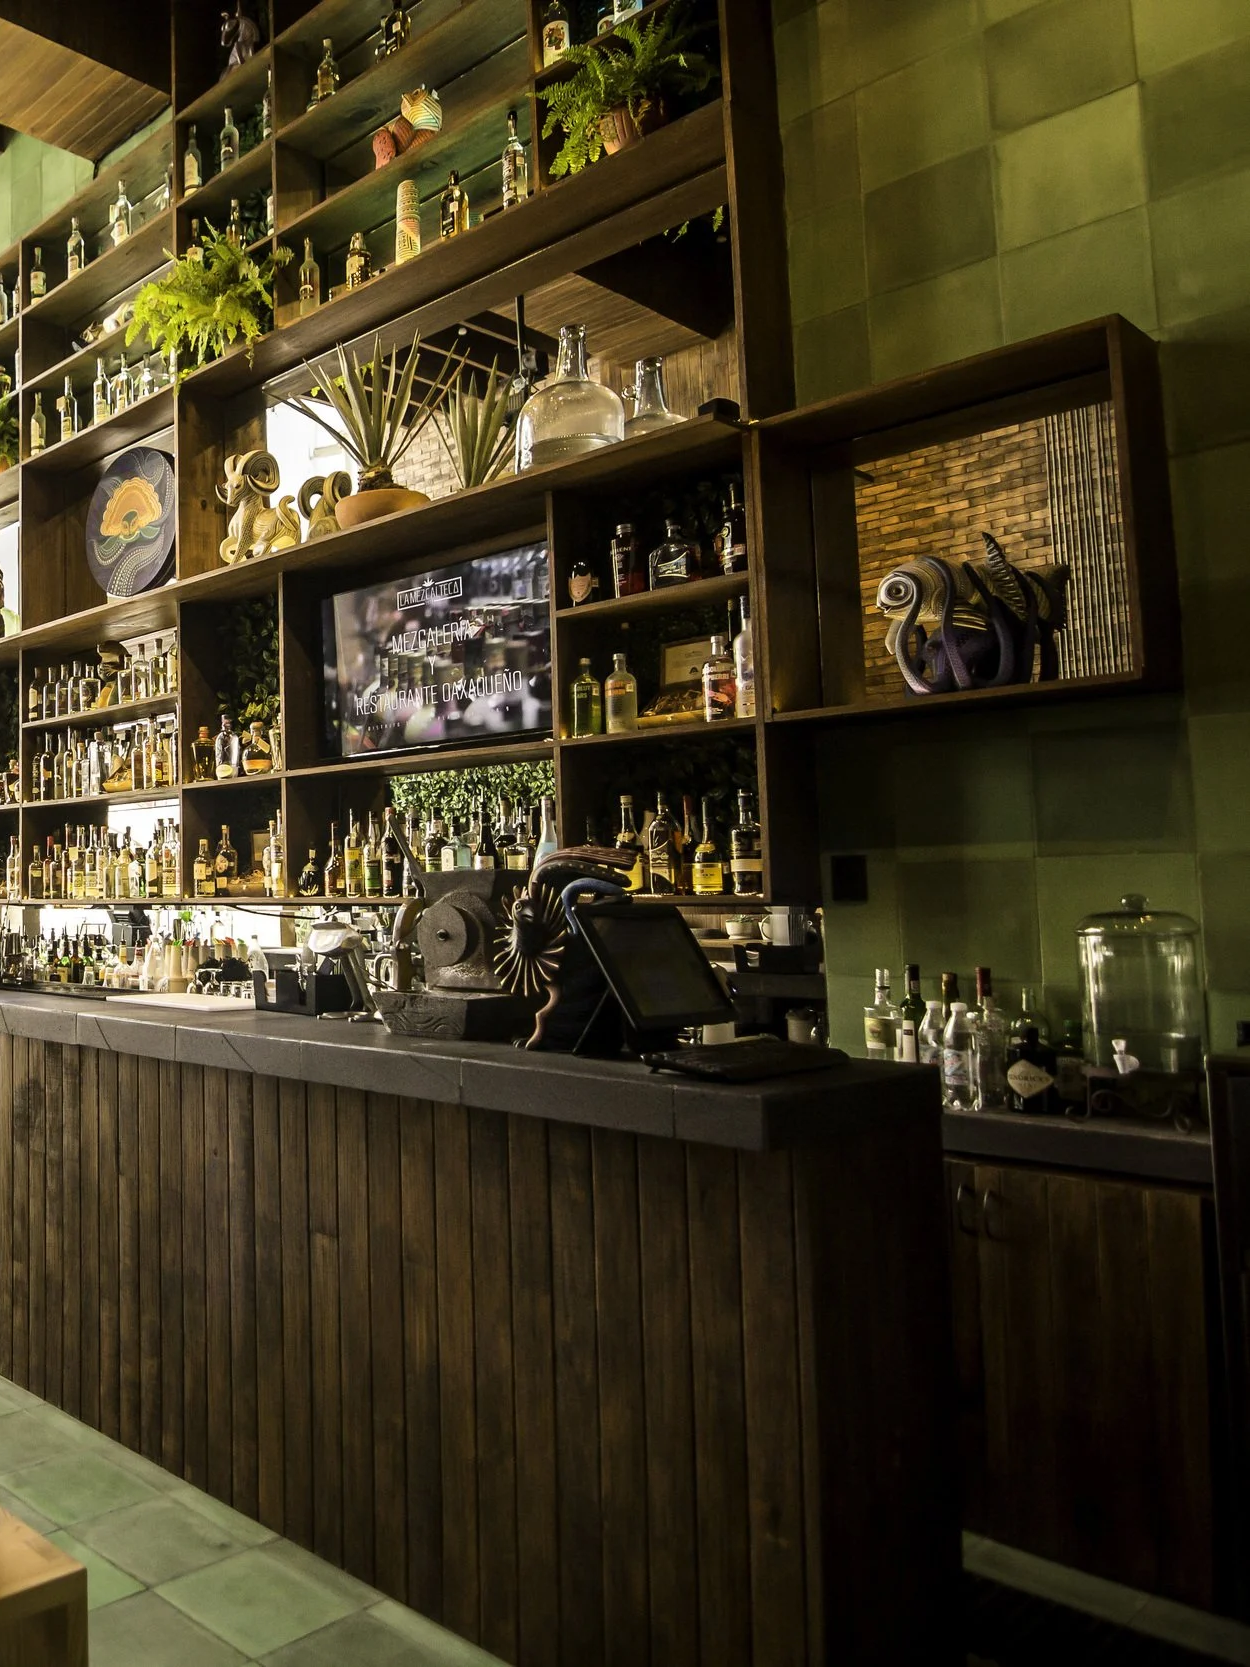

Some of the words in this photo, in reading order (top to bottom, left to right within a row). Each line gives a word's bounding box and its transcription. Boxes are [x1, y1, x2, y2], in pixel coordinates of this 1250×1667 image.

[409, 581, 460, 604] MEZCALTECA
[392, 616, 473, 655] MEZCALERÍA
[427, 655, 436, 675] Y
[355, 684, 438, 716] RESTAURANTE
[442, 668, 523, 702] OAXAQUEÑO
